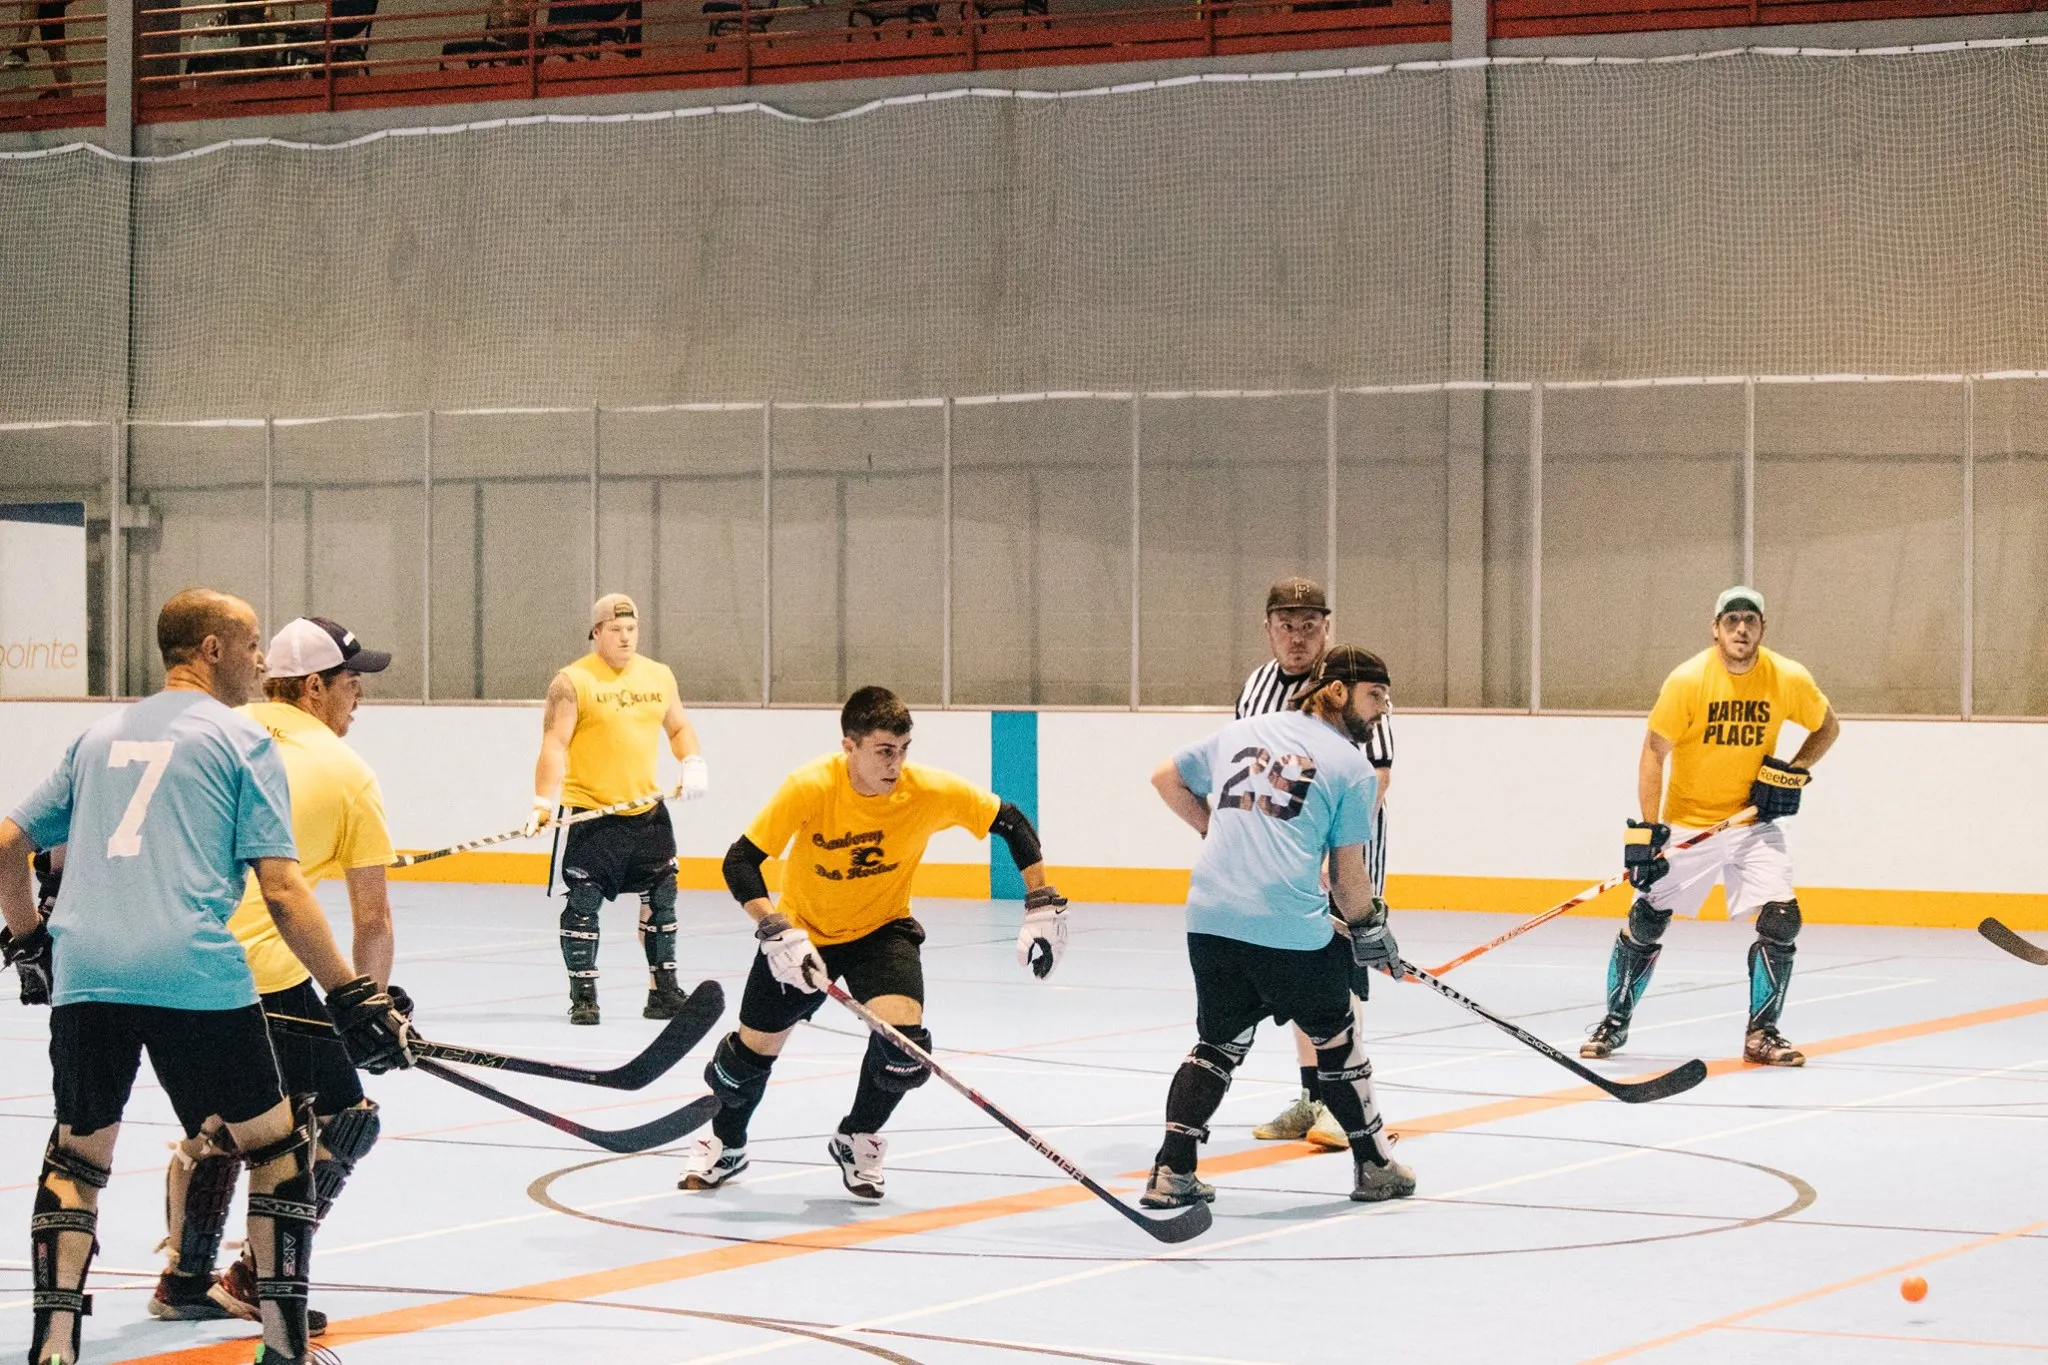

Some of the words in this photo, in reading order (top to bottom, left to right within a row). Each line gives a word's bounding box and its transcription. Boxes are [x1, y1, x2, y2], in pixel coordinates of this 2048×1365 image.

[1703, 724, 1766, 746] PLACE
[1760, 767, 1802, 788] Reebok
[107, 740, 174, 859] 7
